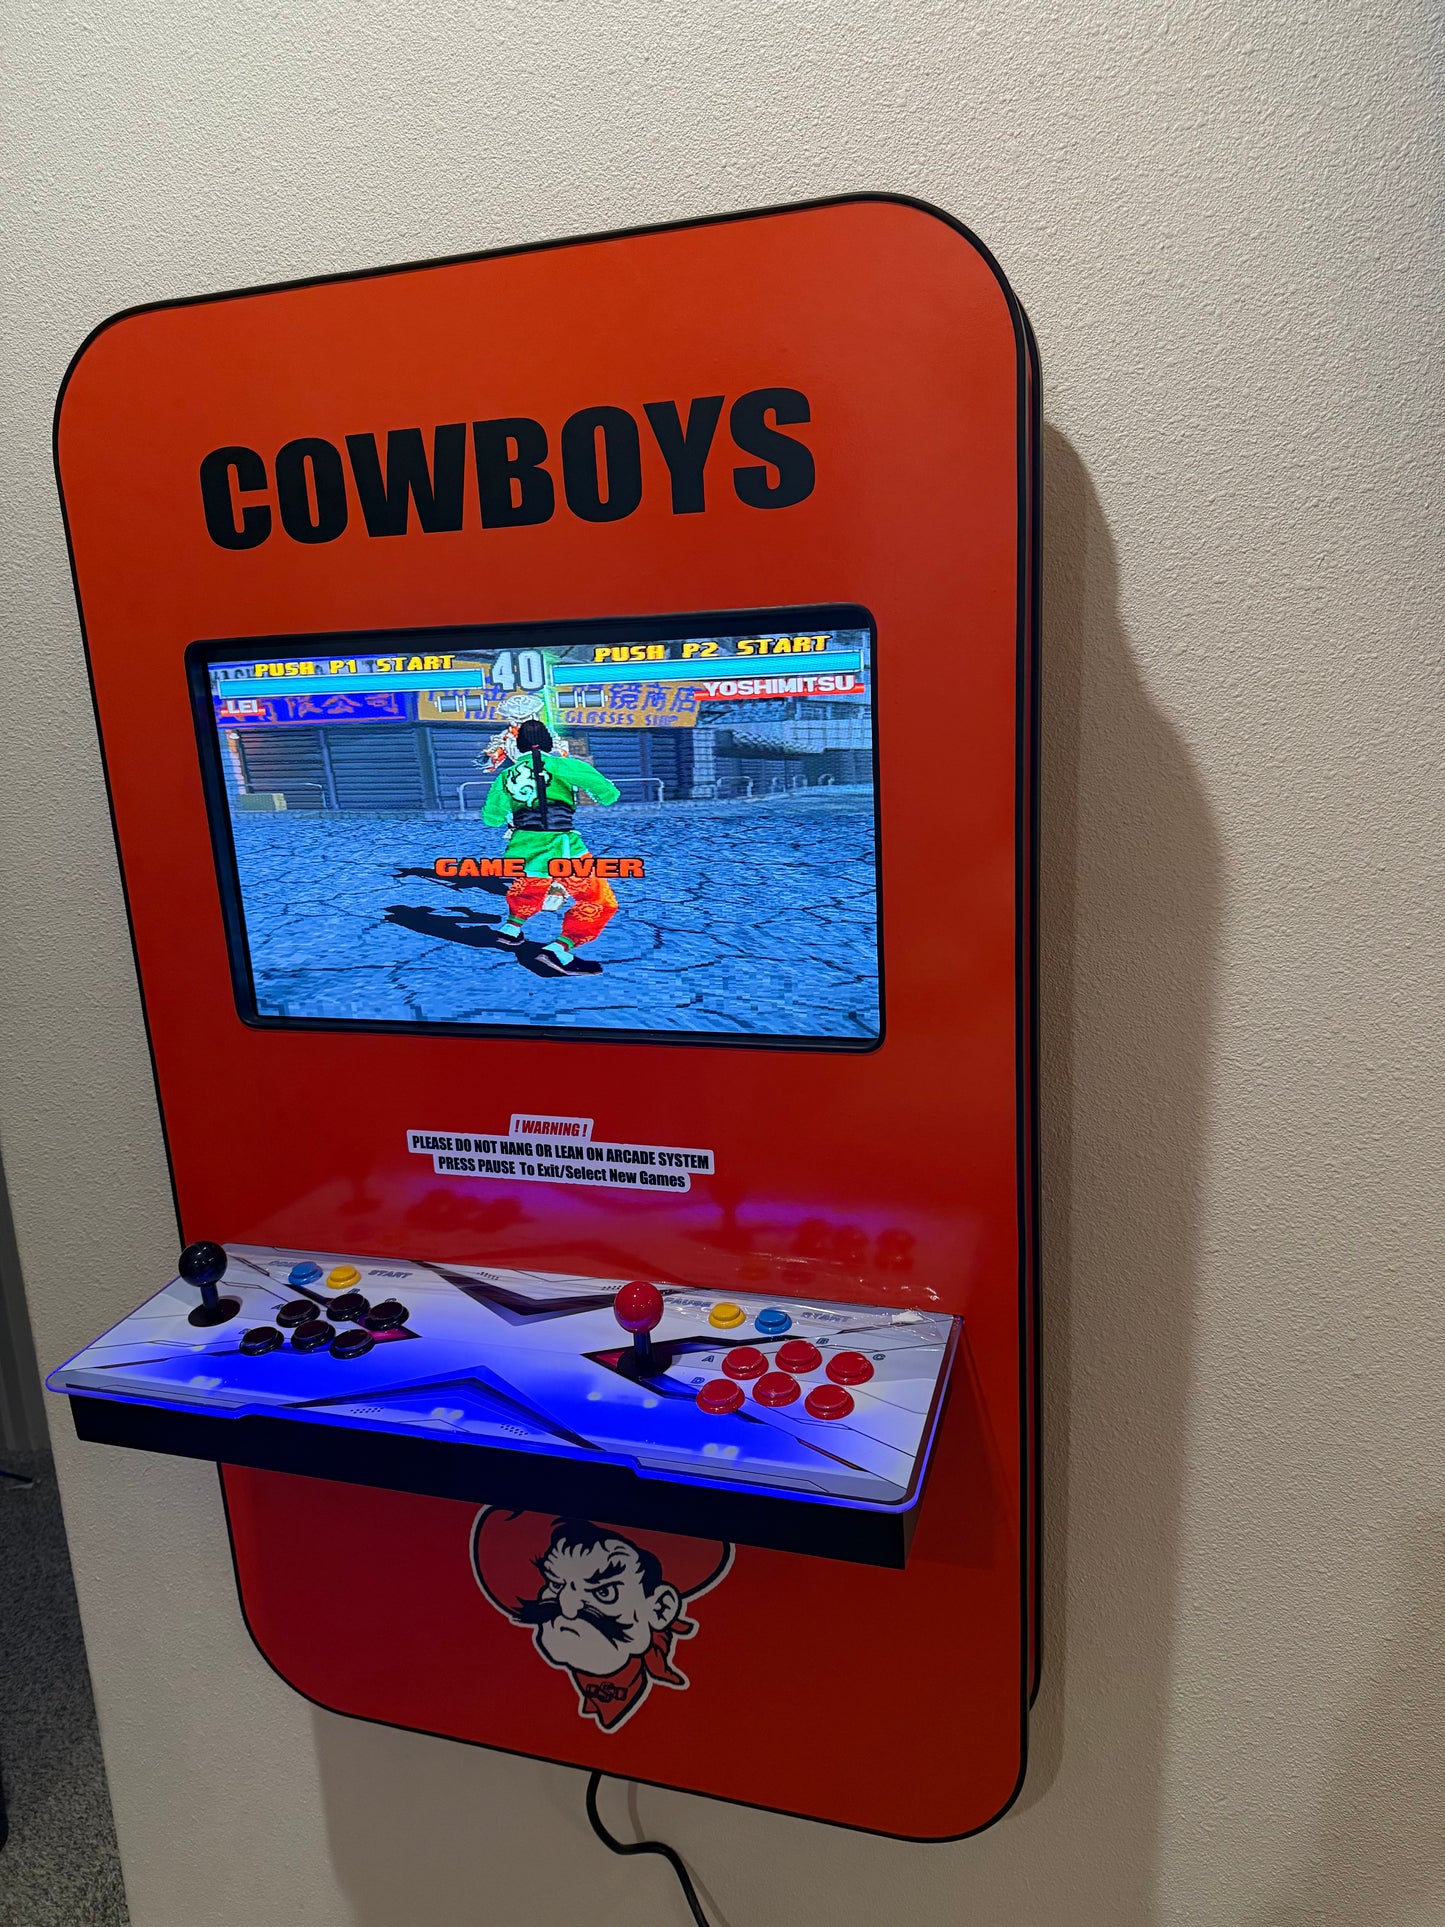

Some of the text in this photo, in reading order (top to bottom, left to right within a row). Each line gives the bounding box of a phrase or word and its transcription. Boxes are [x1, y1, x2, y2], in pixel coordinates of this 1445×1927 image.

[200, 387, 816, 551] COWBOYS
[593, 635, 832, 663] PUSH P2 START
[254, 661, 316, 678] PUSH
[329, 659, 357, 674] P1
[375, 655, 456, 673] START
[491, 650, 545, 691] 40
[702, 675, 856, 697] YOSHIMITSU
[226, 699, 259, 714] LEI
[434, 857, 645, 878] GAME OVER
[521, 1120, 581, 1137] WARNING
[412, 1136, 709, 1170] PLEASE DO NOT HANG OR LEAN ON ARCADE SYSTEM
[438, 1156, 686, 1188] PRESS PAUSE To Exit/Select New Games
[368, 1270, 413, 1279] START
[664, 1297, 713, 1308] PAUSE
[816, 1337, 830, 1345] B
[701, 1355, 715, 1363] A
[872, 1353, 886, 1361] C
